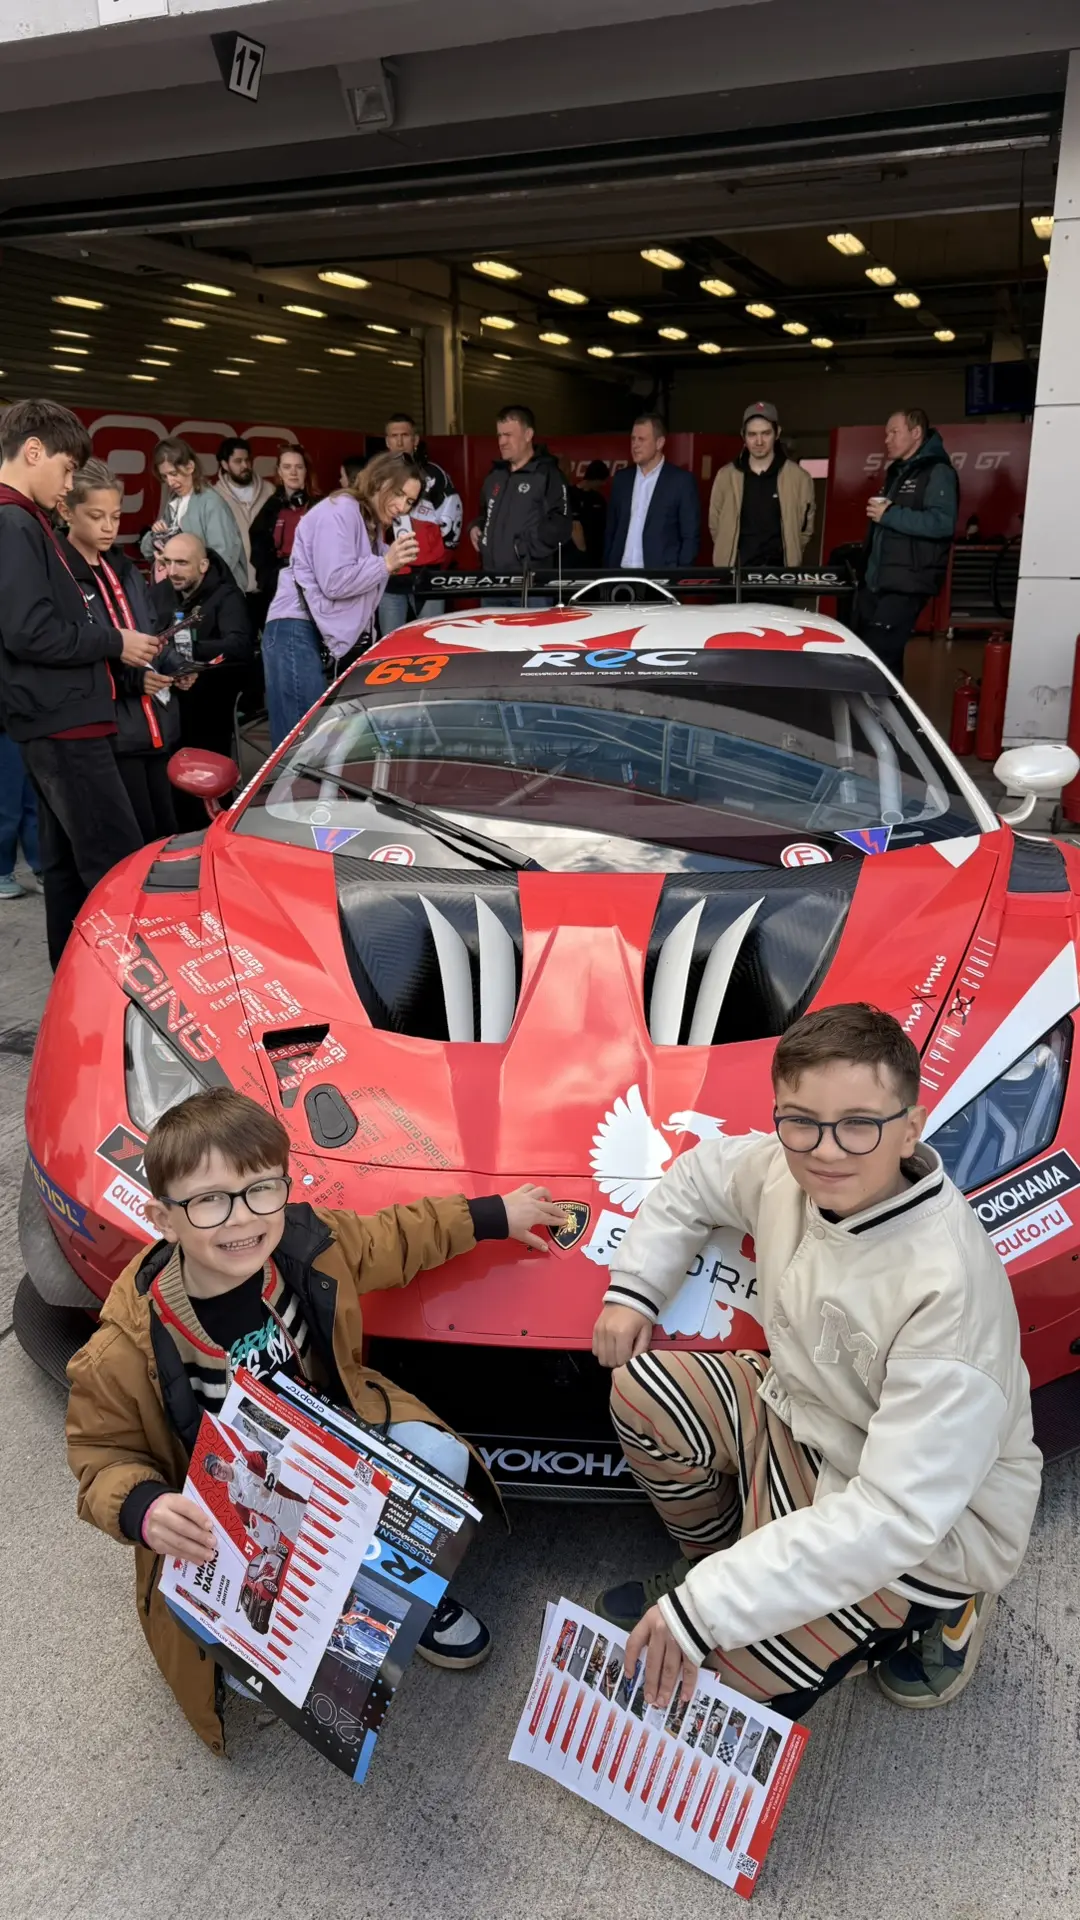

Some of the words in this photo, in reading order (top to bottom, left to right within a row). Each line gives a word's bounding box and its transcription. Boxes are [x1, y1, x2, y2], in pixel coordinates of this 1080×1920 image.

[236, 46, 261, 90] 17
[974, 452, 1009, 470] GT
[430, 576, 524, 586] CREATE
[747, 573, 838, 581] RACING
[364, 655, 449, 685] 63
[112, 1184, 152, 1225] auto.
[995, 1209, 1065, 1256] auto.ru
[814, 1301, 878, 1387] M
[384, 1511, 406, 1527] MRW
[388, 1506, 409, 1522] MRW
[245, 1541, 255, 1555] 57
[379, 1518, 436, 1558] РОССИЙСКАЯ
[379, 1526, 433, 1565] RUSSIAN
[527, 1670, 542, 1710] ЗРИТЕЛЬСКИЕ
[539, 1645, 551, 1671] АКТИВНОСТИ
